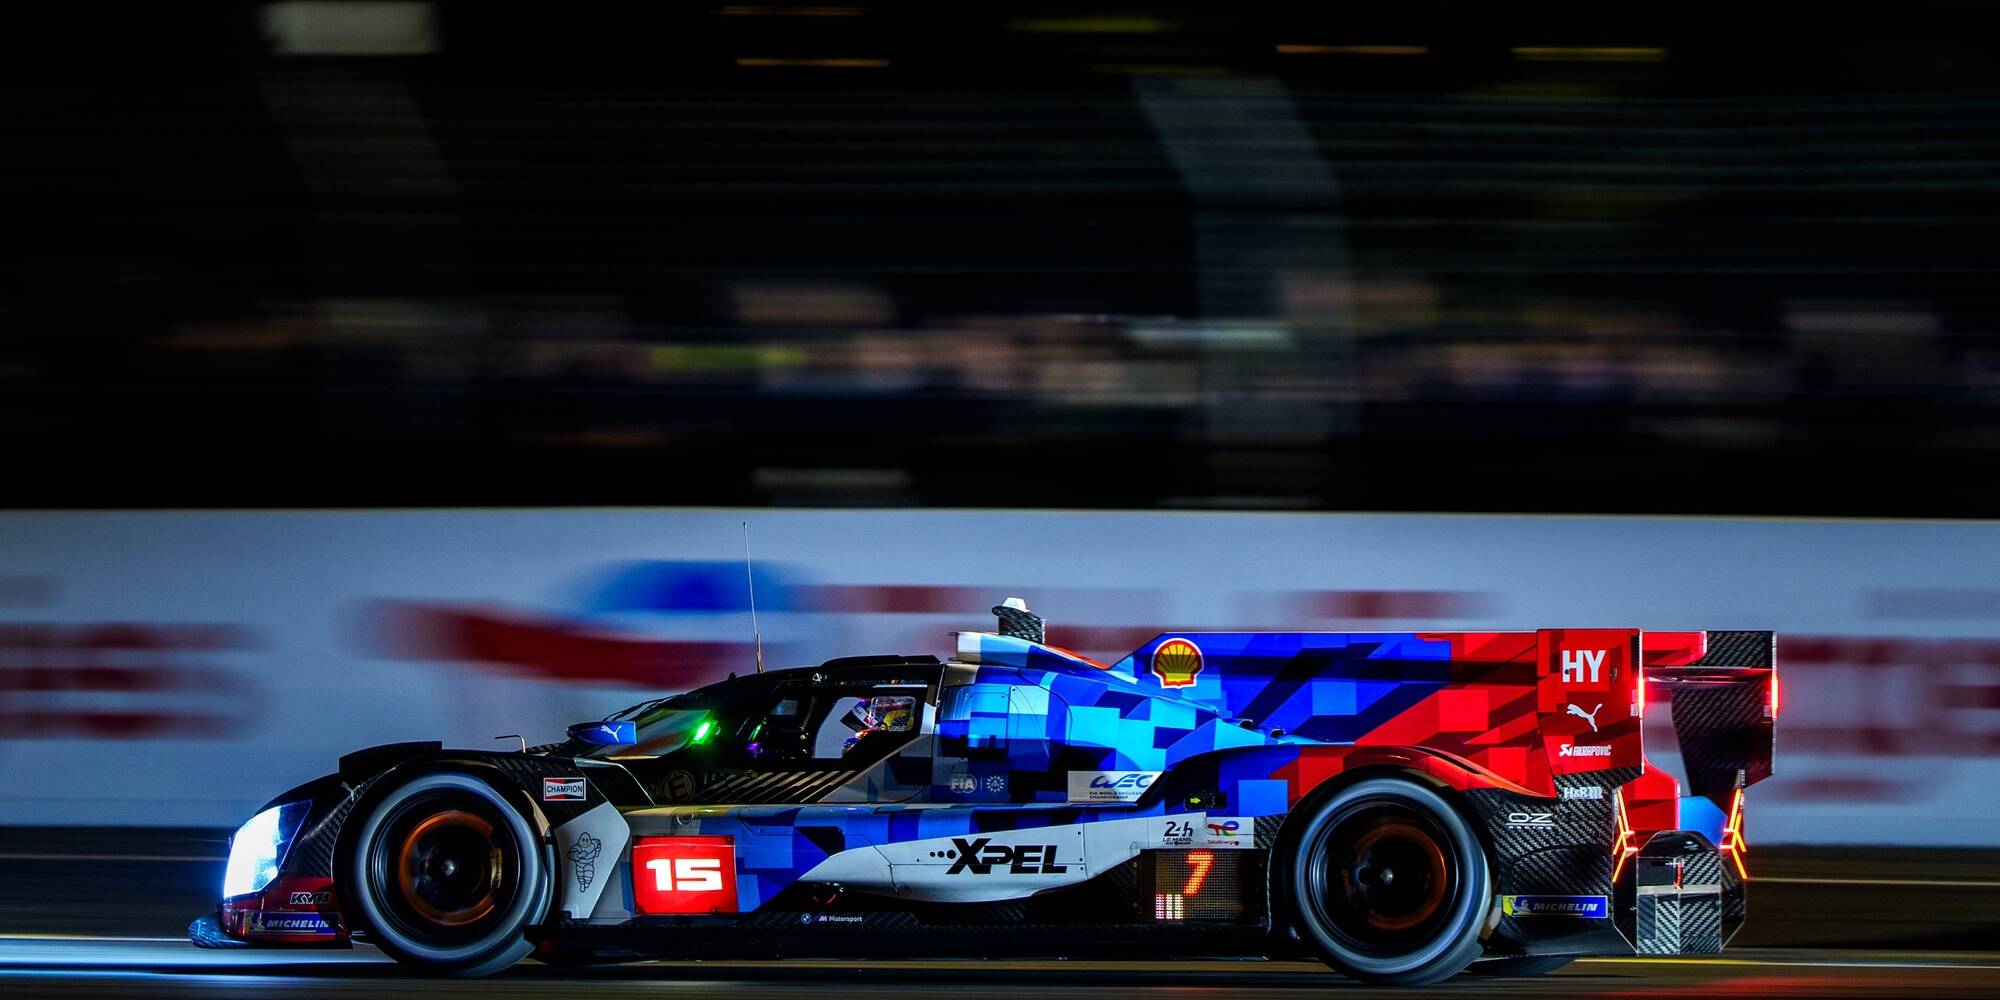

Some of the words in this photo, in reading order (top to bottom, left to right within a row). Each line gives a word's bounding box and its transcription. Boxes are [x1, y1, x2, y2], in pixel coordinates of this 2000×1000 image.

[1562, 650, 1607, 683] HY
[1089, 773, 1154, 789] WEC
[546, 785, 583, 793] CHAMPION
[1508, 812, 1553, 823] OZ
[945, 838, 1068, 875] XPEL
[646, 858, 723, 891] 15
[1183, 853, 1215, 895] 7
[1533, 903, 1599, 912] MICHELIN
[266, 919, 330, 929] MICHELIN
[829, 915, 863, 923] Motorsport
